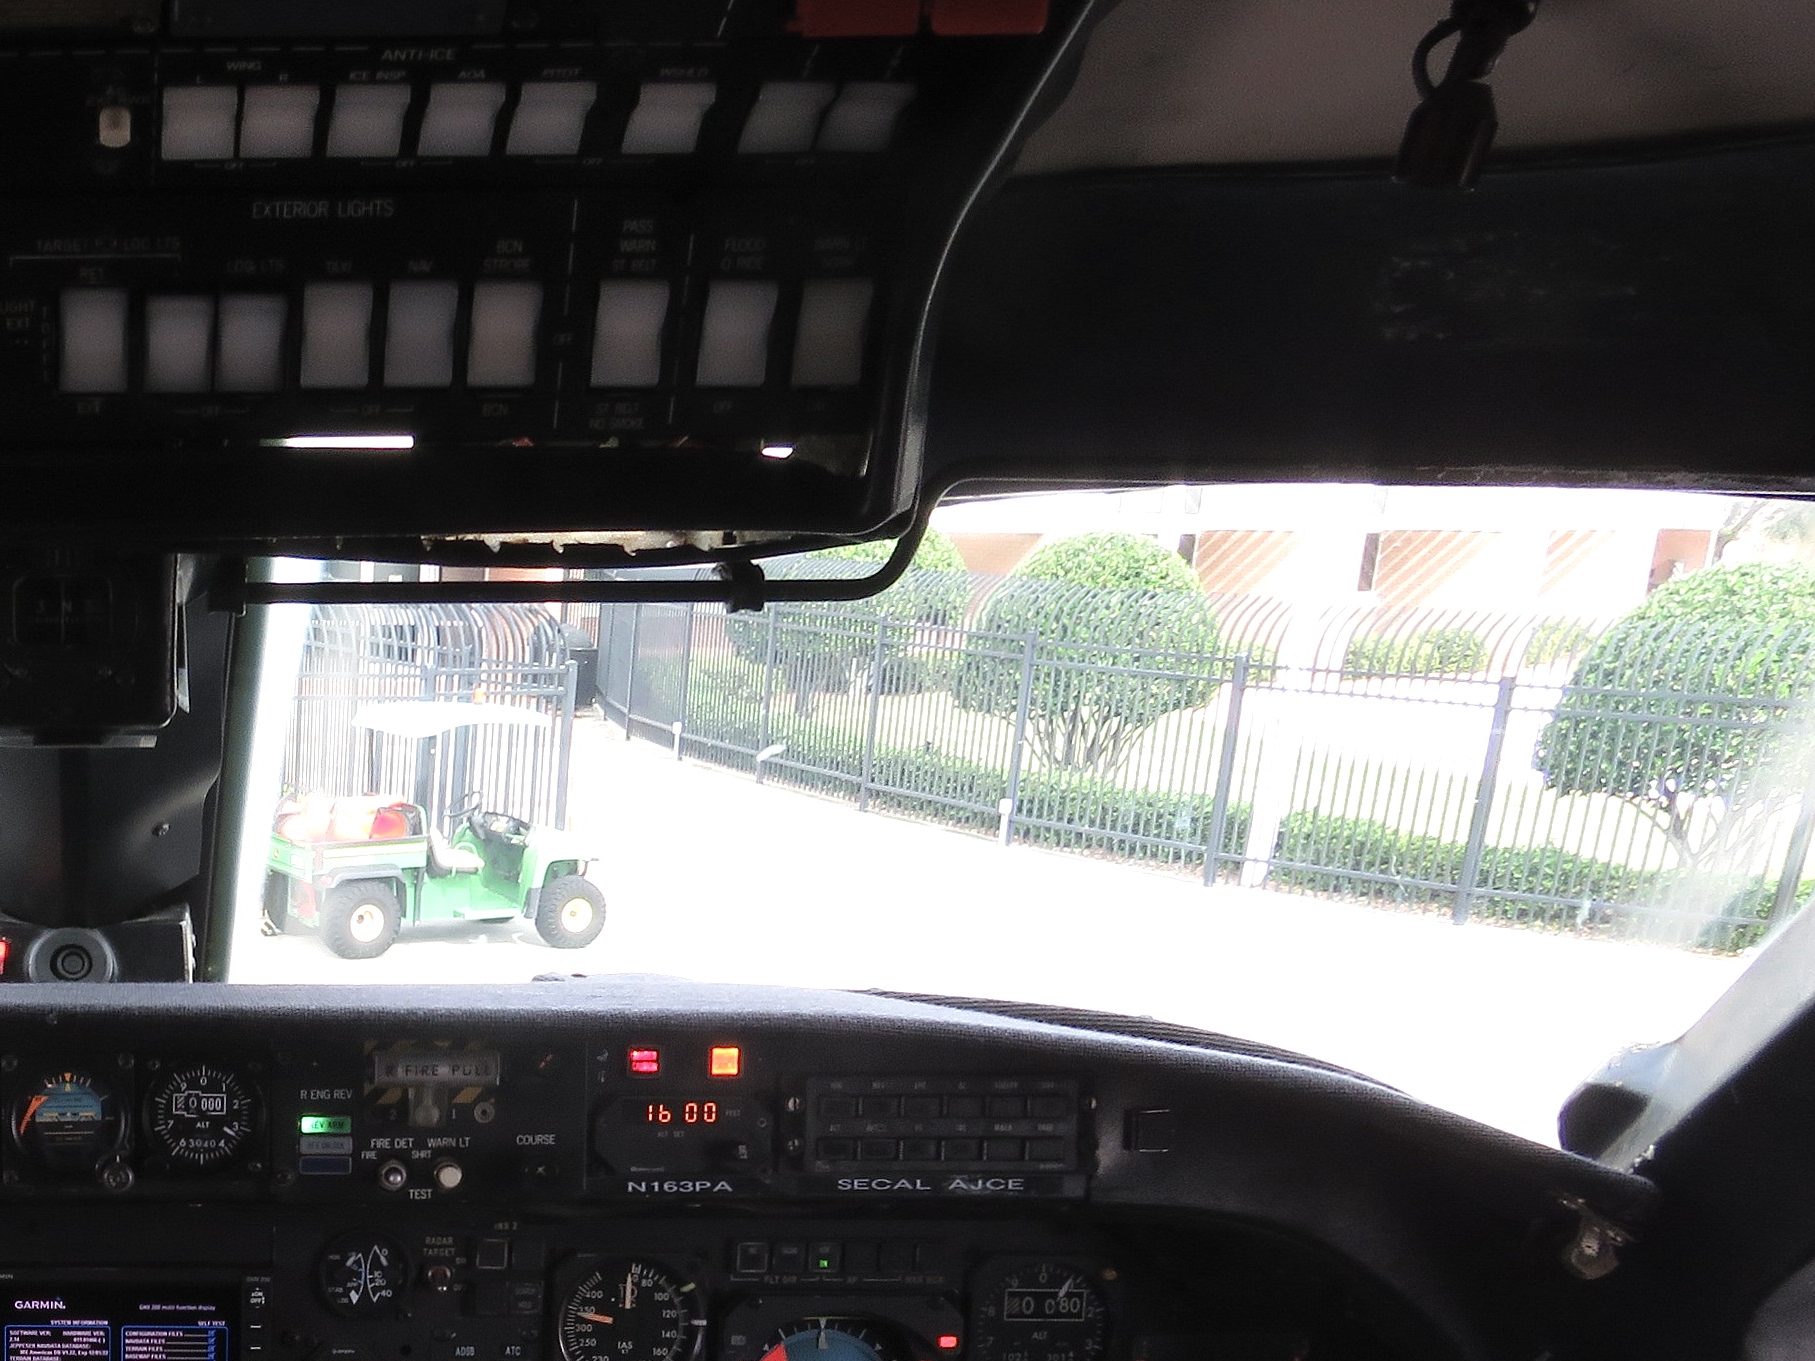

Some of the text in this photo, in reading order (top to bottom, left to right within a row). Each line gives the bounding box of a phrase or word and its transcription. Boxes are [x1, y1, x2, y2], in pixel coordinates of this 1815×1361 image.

[381, 49, 456, 62] ANTI-ICE
[252, 200, 394, 220] EXTERIOR LIGHTS
[301, 1089, 352, 1099] R ENG REV
[371, 1138, 414, 1149] FIRE DET
[427, 1137, 470, 1148] WARN LT
[516, 1135, 556, 1145] COURSE
[361, 1151, 377, 1159] FIRE
[412, 1150, 431, 1159] SHRT
[627, 1181, 733, 1193] N163PA
[837, 1178, 1024, 1191] SECAL AJCE
[409, 1189, 432, 1200] TEST
[15, 1301, 66, 1310] GARMIN
[455, 1347, 475, 1357] ADSB
[505, 1347, 521, 1356] ATC
